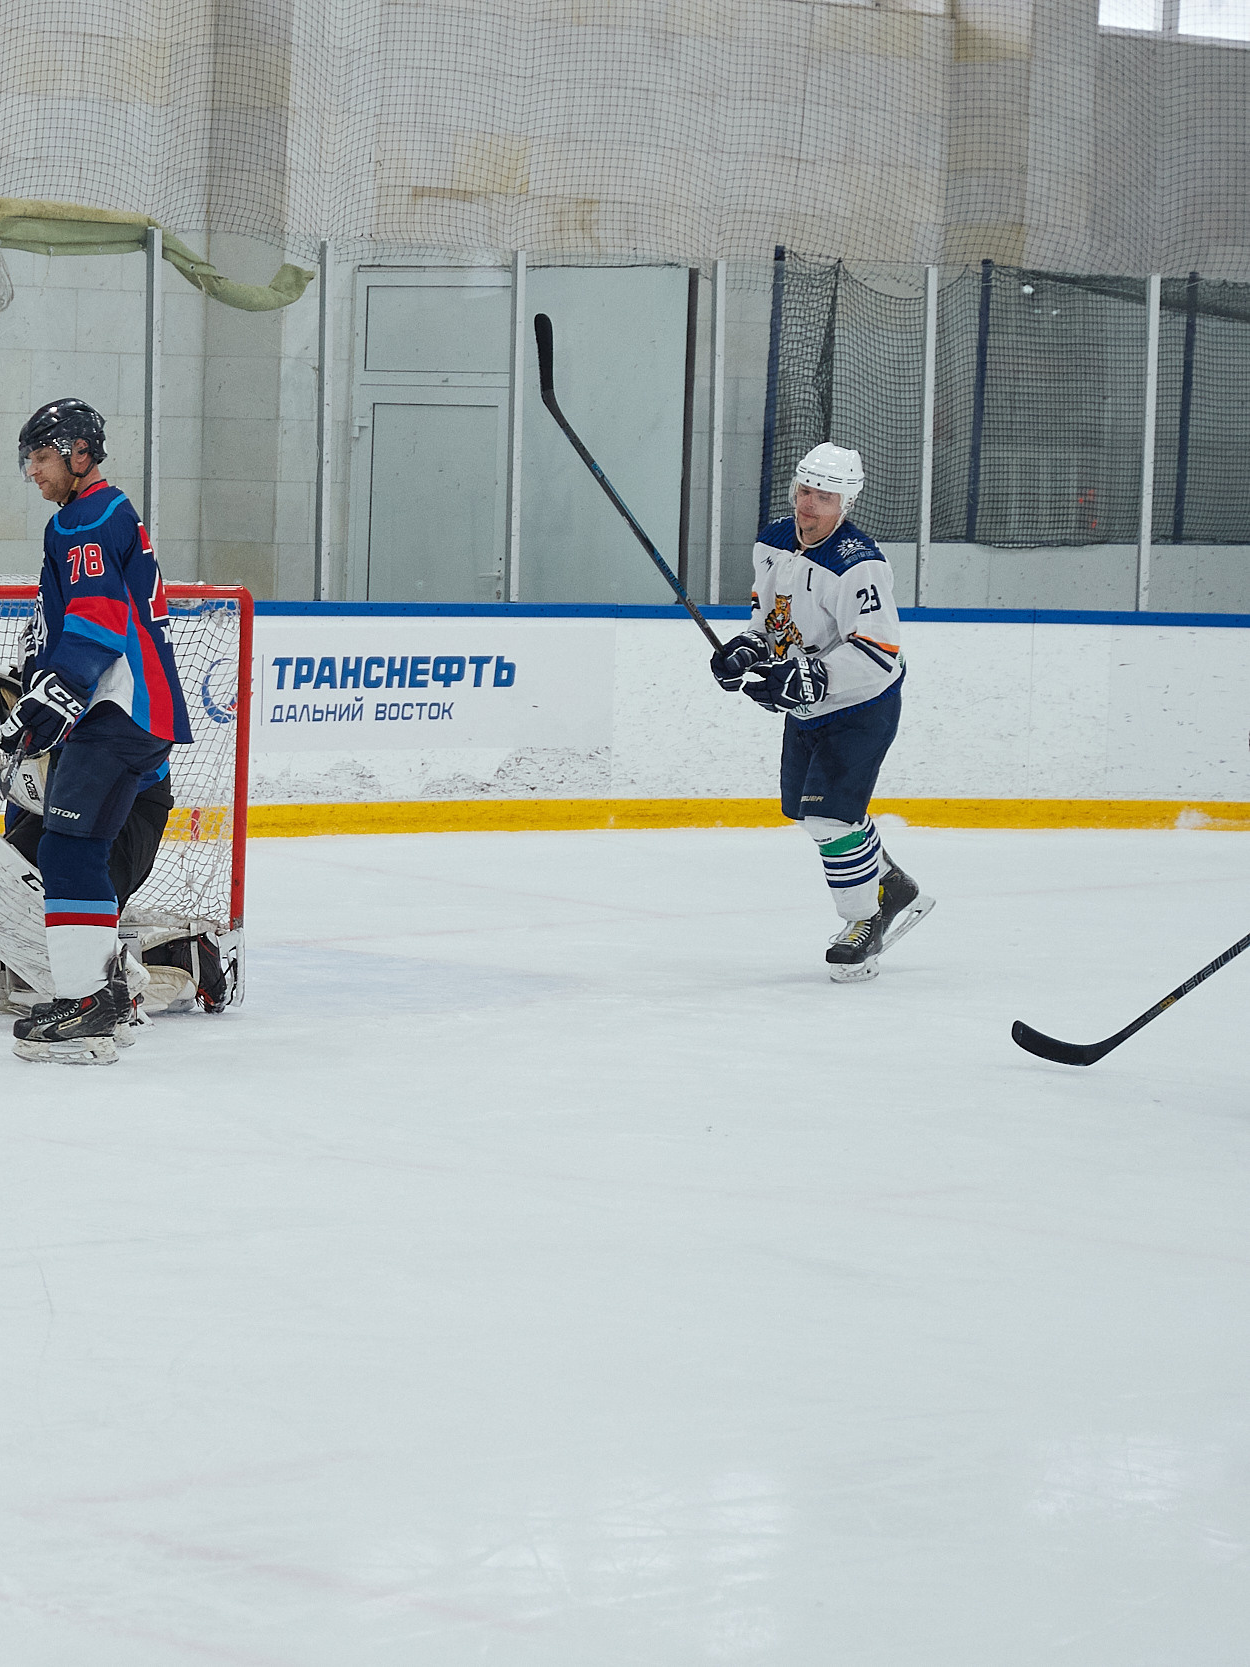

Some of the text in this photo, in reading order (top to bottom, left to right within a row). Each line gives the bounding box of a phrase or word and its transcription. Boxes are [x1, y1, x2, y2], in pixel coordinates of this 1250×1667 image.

[66, 543, 105, 585] 78
[856, 584, 882, 615] 23
[271, 655, 517, 690] ТРАНСНЕФТЬ
[48, 683, 84, 715] CC
[270, 696, 454, 723] ДАЛЬНИЙ ВОСТОК
